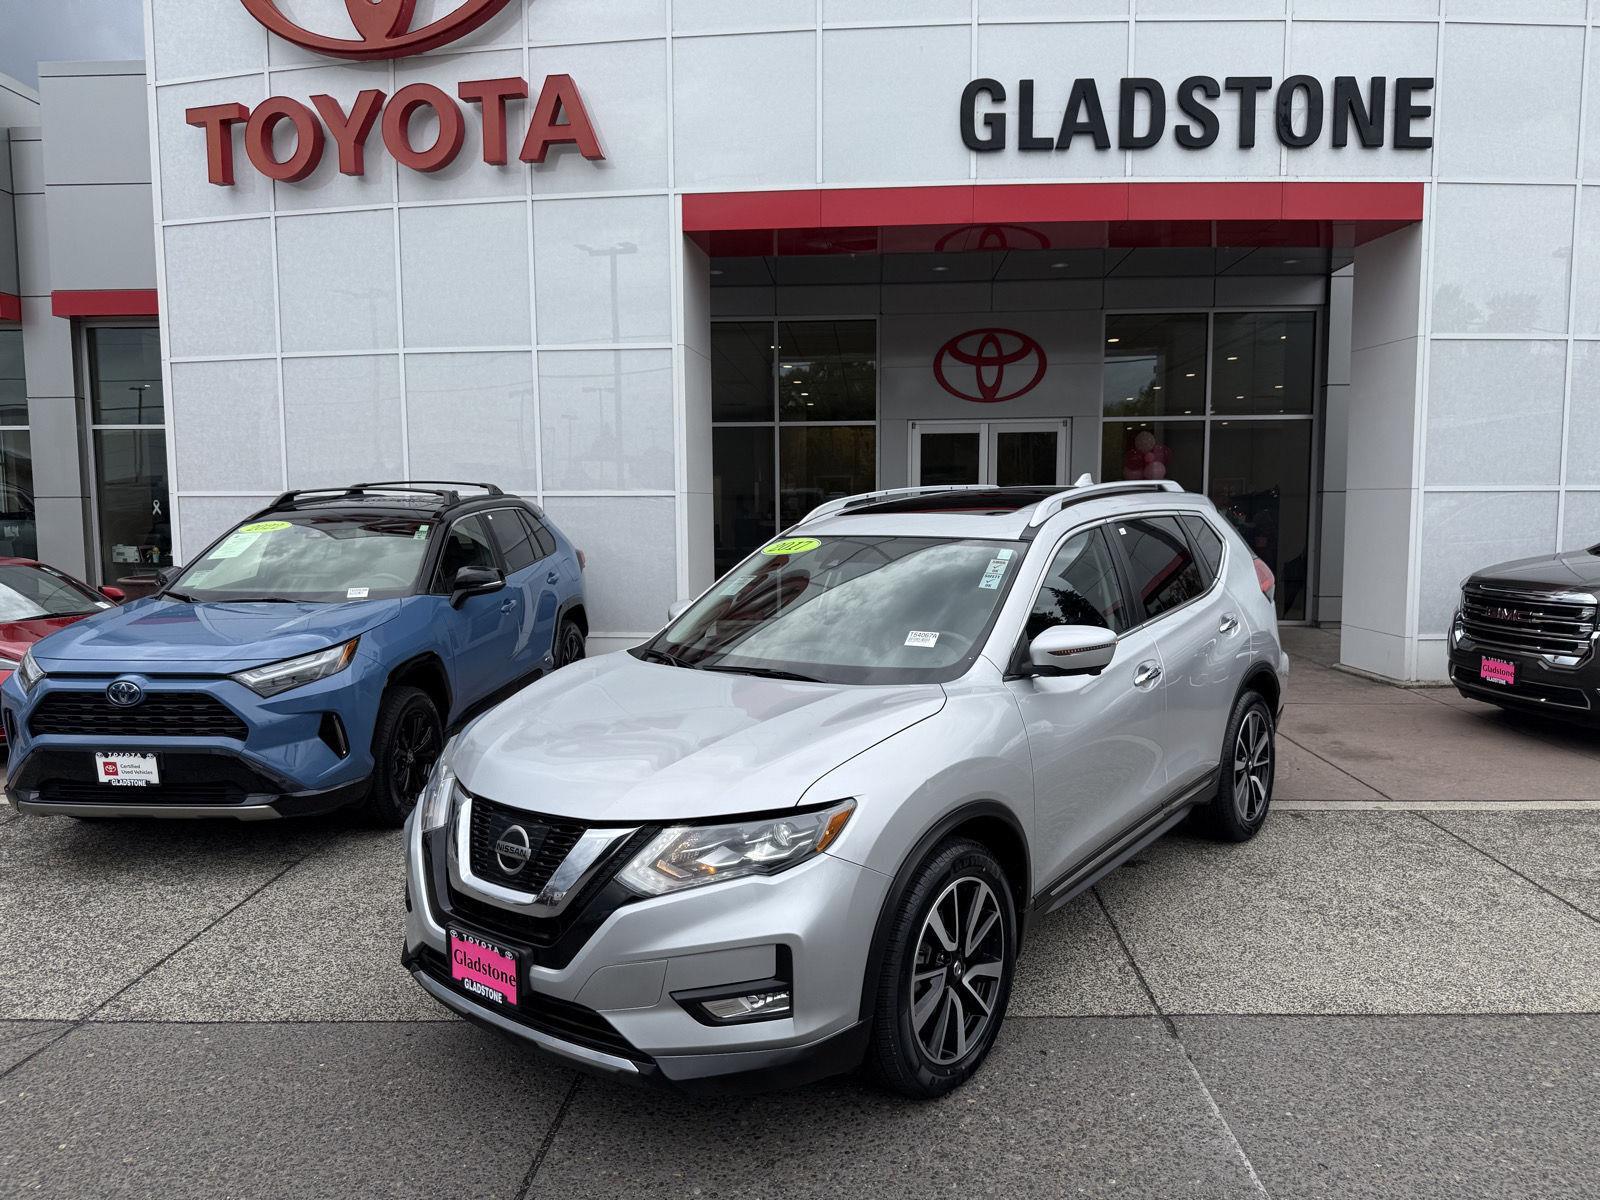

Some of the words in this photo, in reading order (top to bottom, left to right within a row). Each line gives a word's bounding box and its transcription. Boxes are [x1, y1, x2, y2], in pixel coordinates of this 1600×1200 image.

[960, 75, 1434, 152] GLADSTONE
[186, 74, 606, 186] TOYOTA
[767, 540, 814, 553] 2017
[1483, 665, 1515, 677] Gladstone
[111, 779, 147, 787] GLADSTONE
[496, 842, 527, 857] NISSAN
[462, 934, 499, 953] TOYOTA
[454, 949, 516, 987] Gladstone
[464, 978, 503, 1004] GLADSTONE
